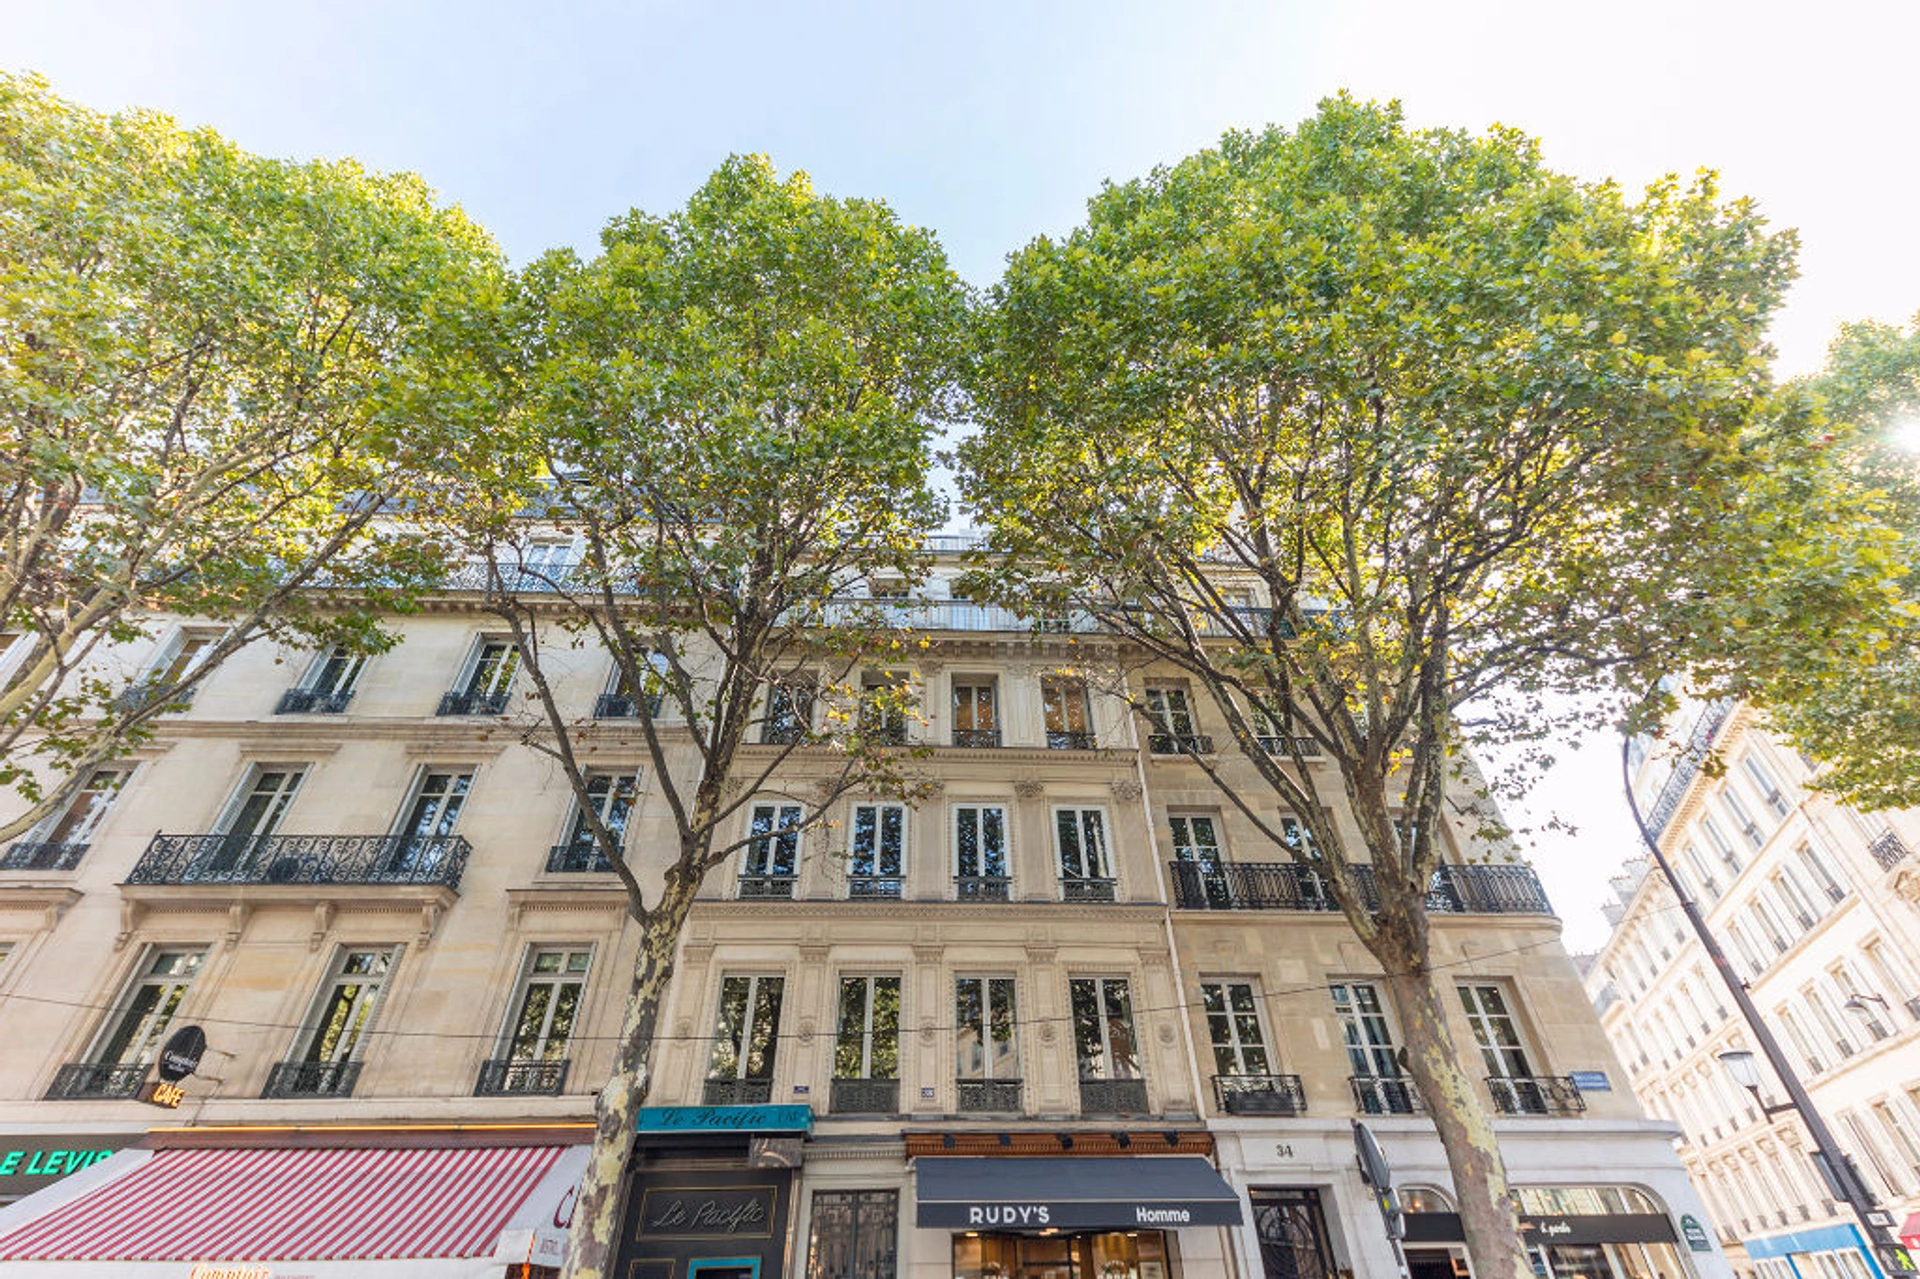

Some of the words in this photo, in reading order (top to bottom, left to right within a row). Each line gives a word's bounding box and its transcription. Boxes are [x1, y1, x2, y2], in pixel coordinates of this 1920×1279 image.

[661, 1109, 684, 1127] Le
[691, 1108, 767, 1129] Pacific
[1275, 1144, 1294, 1158] 34
[651, 1200, 686, 1227] Le
[690, 1198, 764, 1233] Pacific
[969, 1206, 1050, 1224] RUDY'S
[1136, 1206, 1191, 1222] Homme
